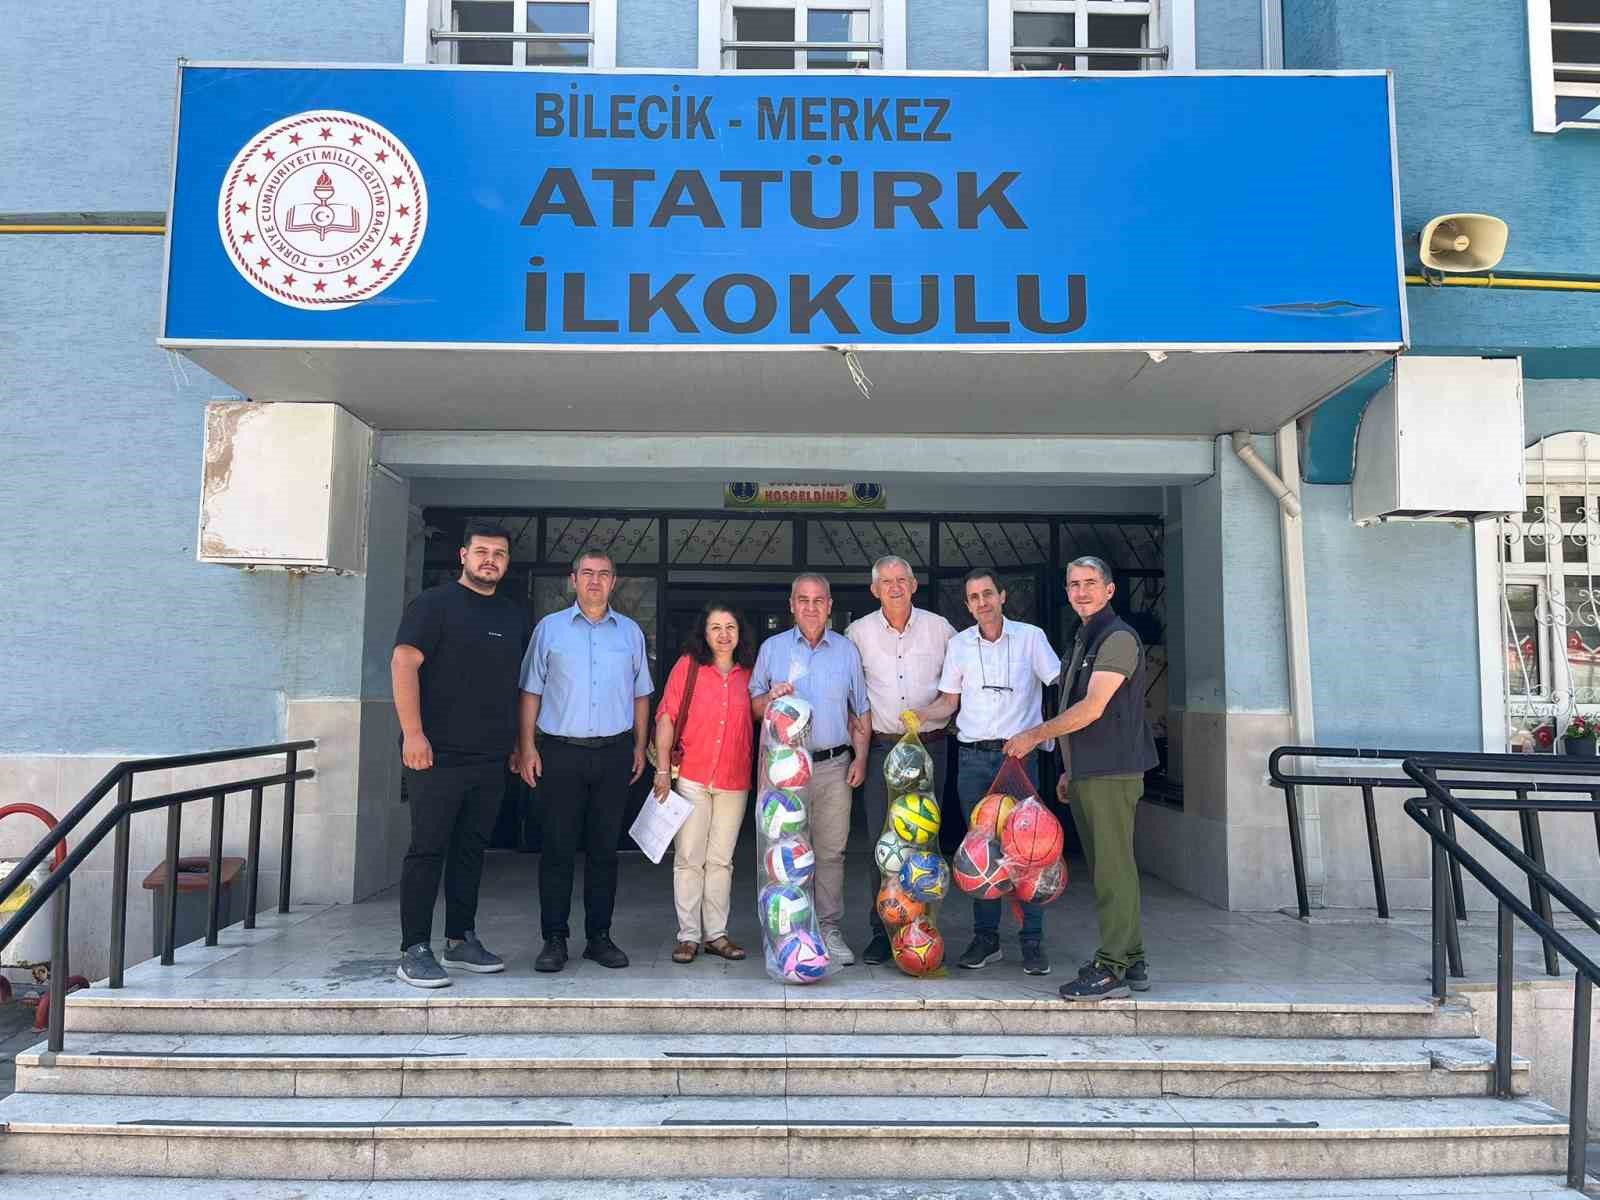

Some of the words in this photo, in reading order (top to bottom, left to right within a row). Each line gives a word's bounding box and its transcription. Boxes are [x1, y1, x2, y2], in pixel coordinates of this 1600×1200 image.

[535, 83, 715, 140] BİLECİK
[757, 96, 952, 142] MERKEZ
[262, 150, 317, 222] CUMHURİYETİ
[321, 149, 358, 167] MİLLİ
[358, 165, 384, 206] EĞİTİM
[520, 154, 1028, 230] ATATÜRK
[264, 226, 308, 267] TÜRKİYE
[336, 210, 385, 267] BAKANLIĞI
[524, 255, 1087, 336] İLKOKULU
